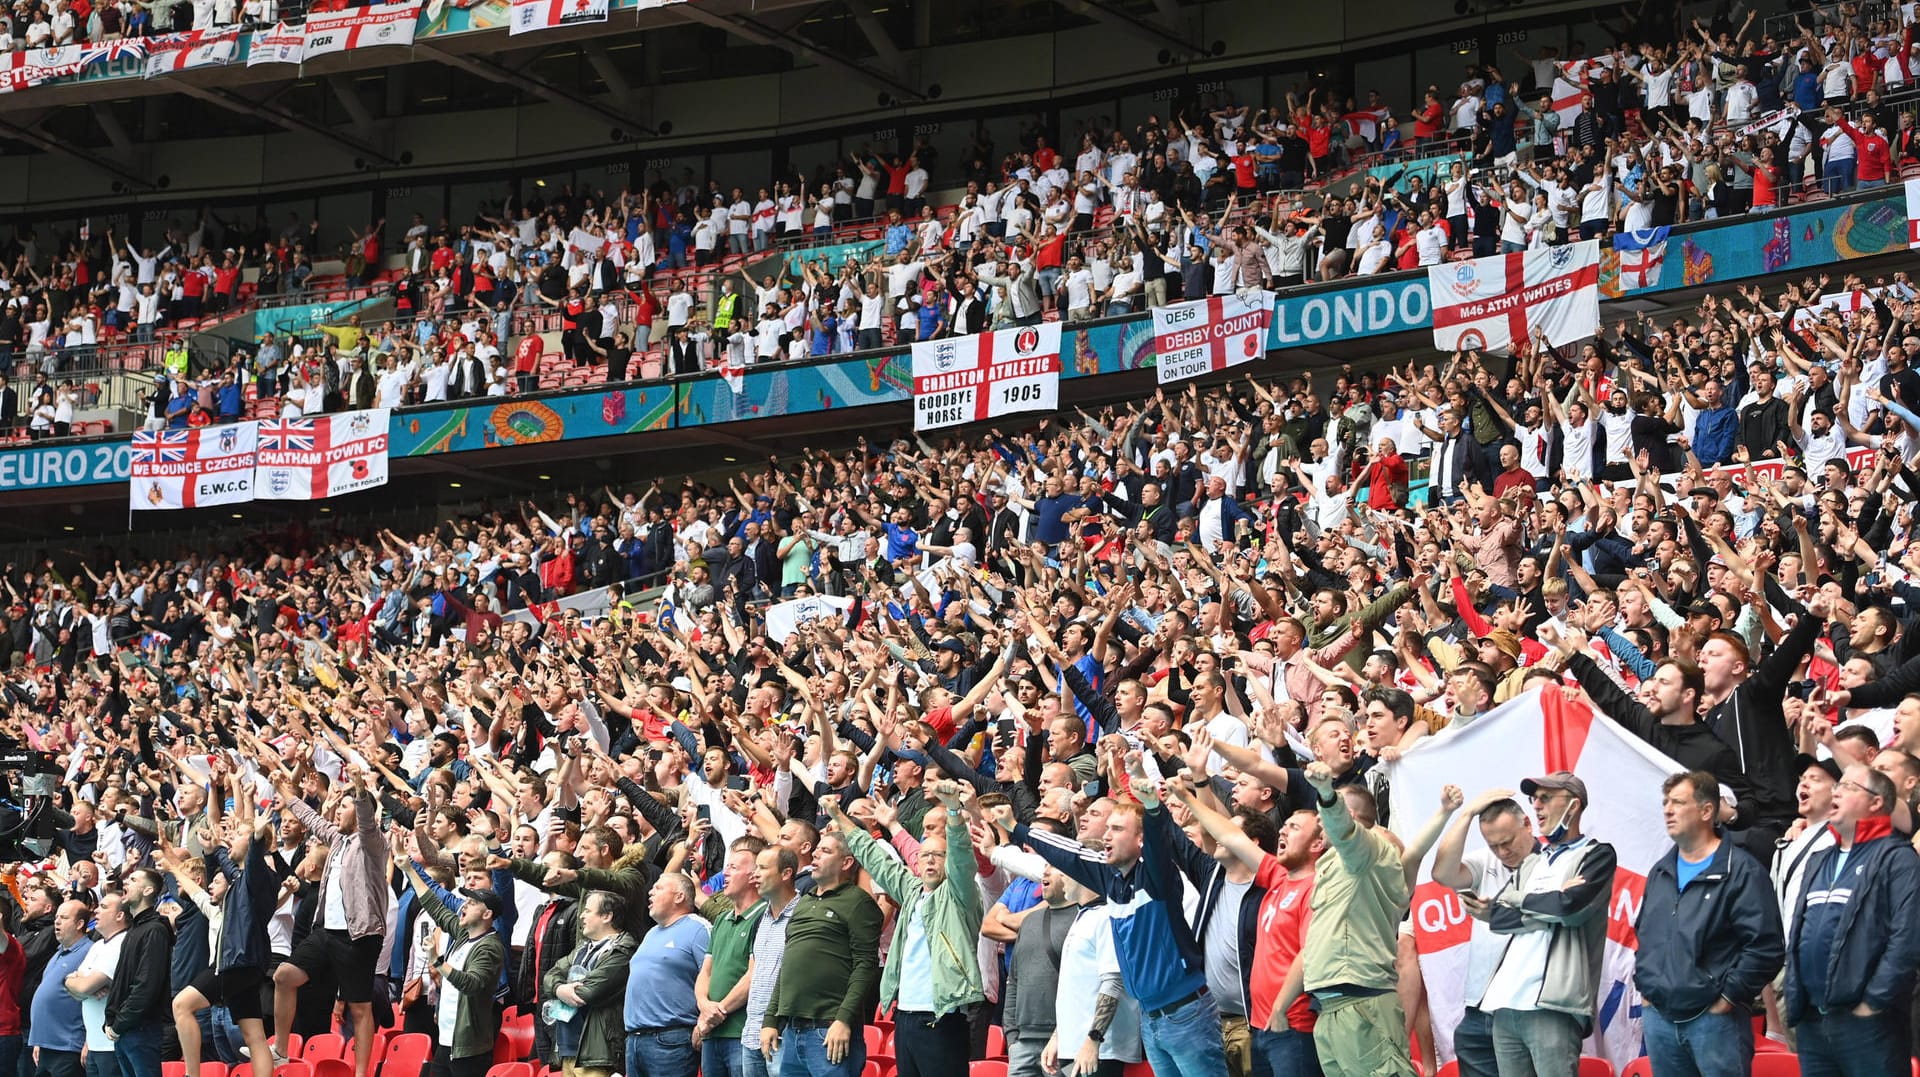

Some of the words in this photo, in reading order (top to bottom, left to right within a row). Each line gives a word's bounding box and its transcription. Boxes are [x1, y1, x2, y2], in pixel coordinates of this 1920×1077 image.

[344, 16, 374, 26] GREEN
[92, 36, 144, 48] EVERTON
[310, 36, 333, 48] FGR
[1451, 38, 1478, 52] 3035
[1497, 31, 1526, 46] 3036
[1196, 81, 1224, 94] 3034
[1460, 303, 1484, 318] M46
[1486, 294, 1520, 314] ATHY
[1522, 278, 1572, 302] WHITES
[1166, 308, 1195, 325] DE56
[1166, 326, 1210, 349] DERBY
[1165, 348, 1203, 365] BELPER
[922, 369, 983, 393] CHARLTON
[988, 358, 1049, 381] ATHLETIC
[1163, 367, 1181, 380] ON
[1183, 361, 1207, 377] TOUR
[919, 390, 972, 410] GOODBYE
[1003, 383, 1041, 404] 1905
[927, 407, 962, 425] HORSE
[258, 450, 322, 466] CHATHAM
[326, 443, 364, 461] TOWN
[367, 438, 385, 452] FC
[0, 446, 97, 488] EURO
[133, 463, 150, 476] WE
[152, 461, 201, 476] BOUNCE
[205, 453, 253, 471] CZECHS
